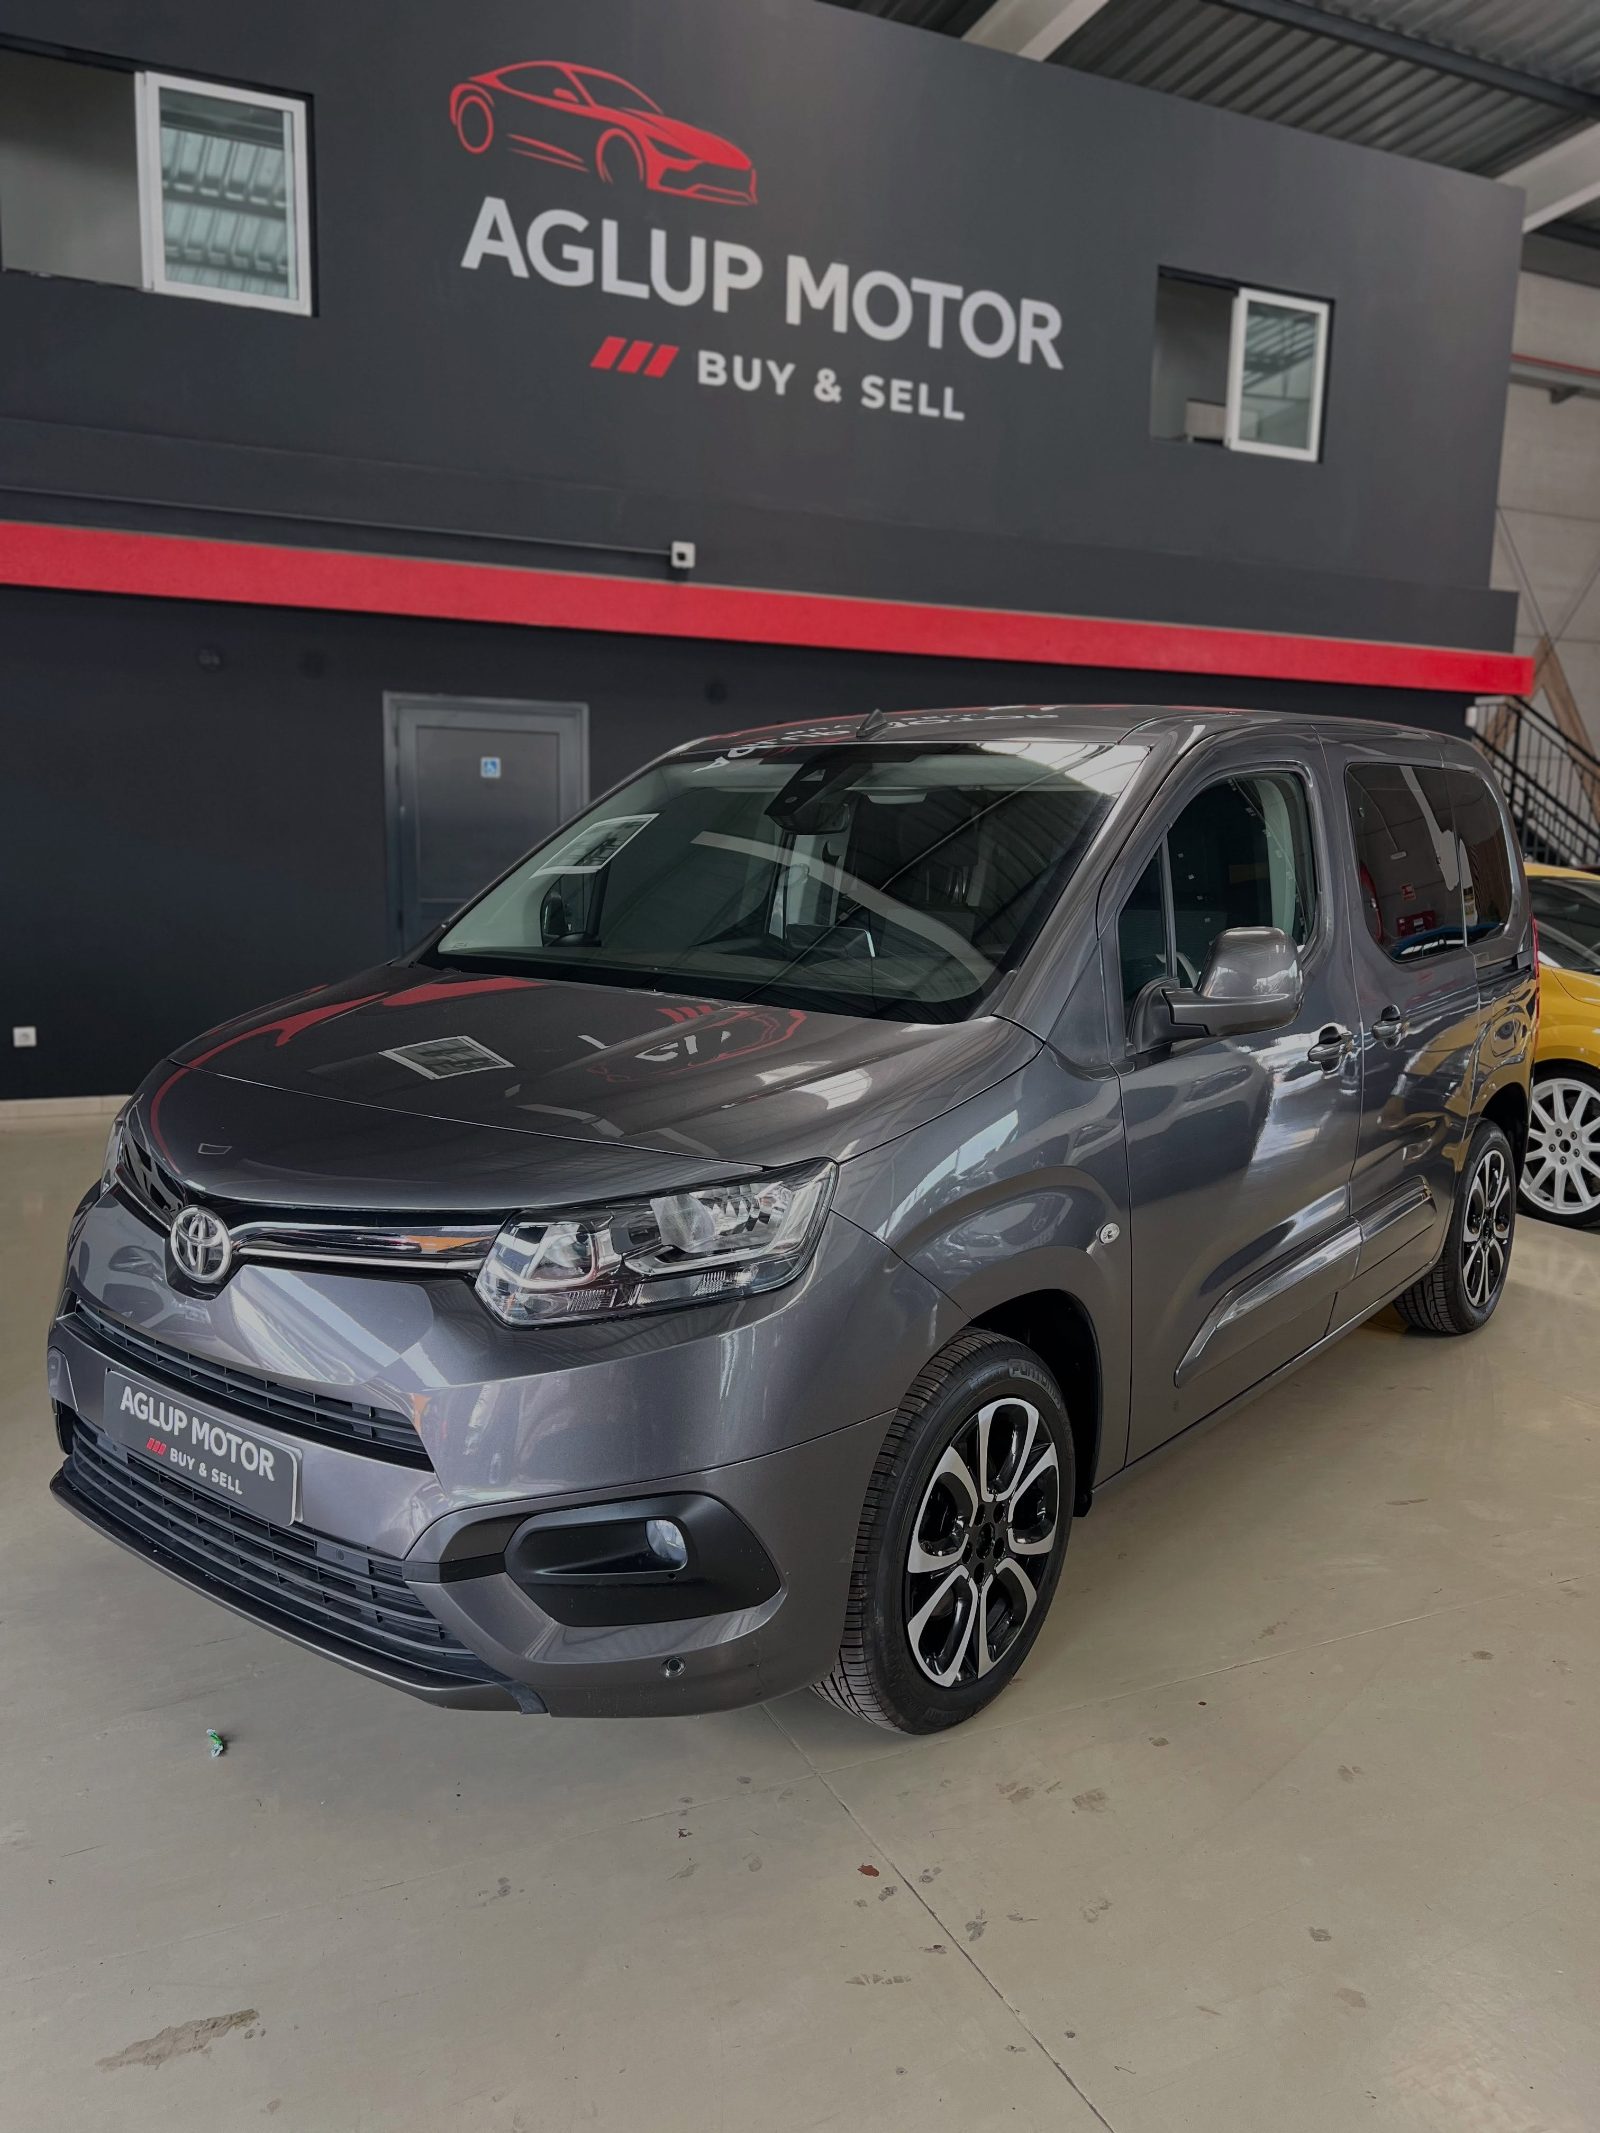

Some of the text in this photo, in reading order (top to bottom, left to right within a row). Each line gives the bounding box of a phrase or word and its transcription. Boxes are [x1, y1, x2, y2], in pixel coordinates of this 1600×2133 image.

[460, 196, 1064, 370] AGLUP MOTOR
[698, 349, 965, 421] BUY & SELL
[120, 1385, 275, 1482] AGLUP MOTOR
[170, 1447, 243, 1495] BUY & SELL
